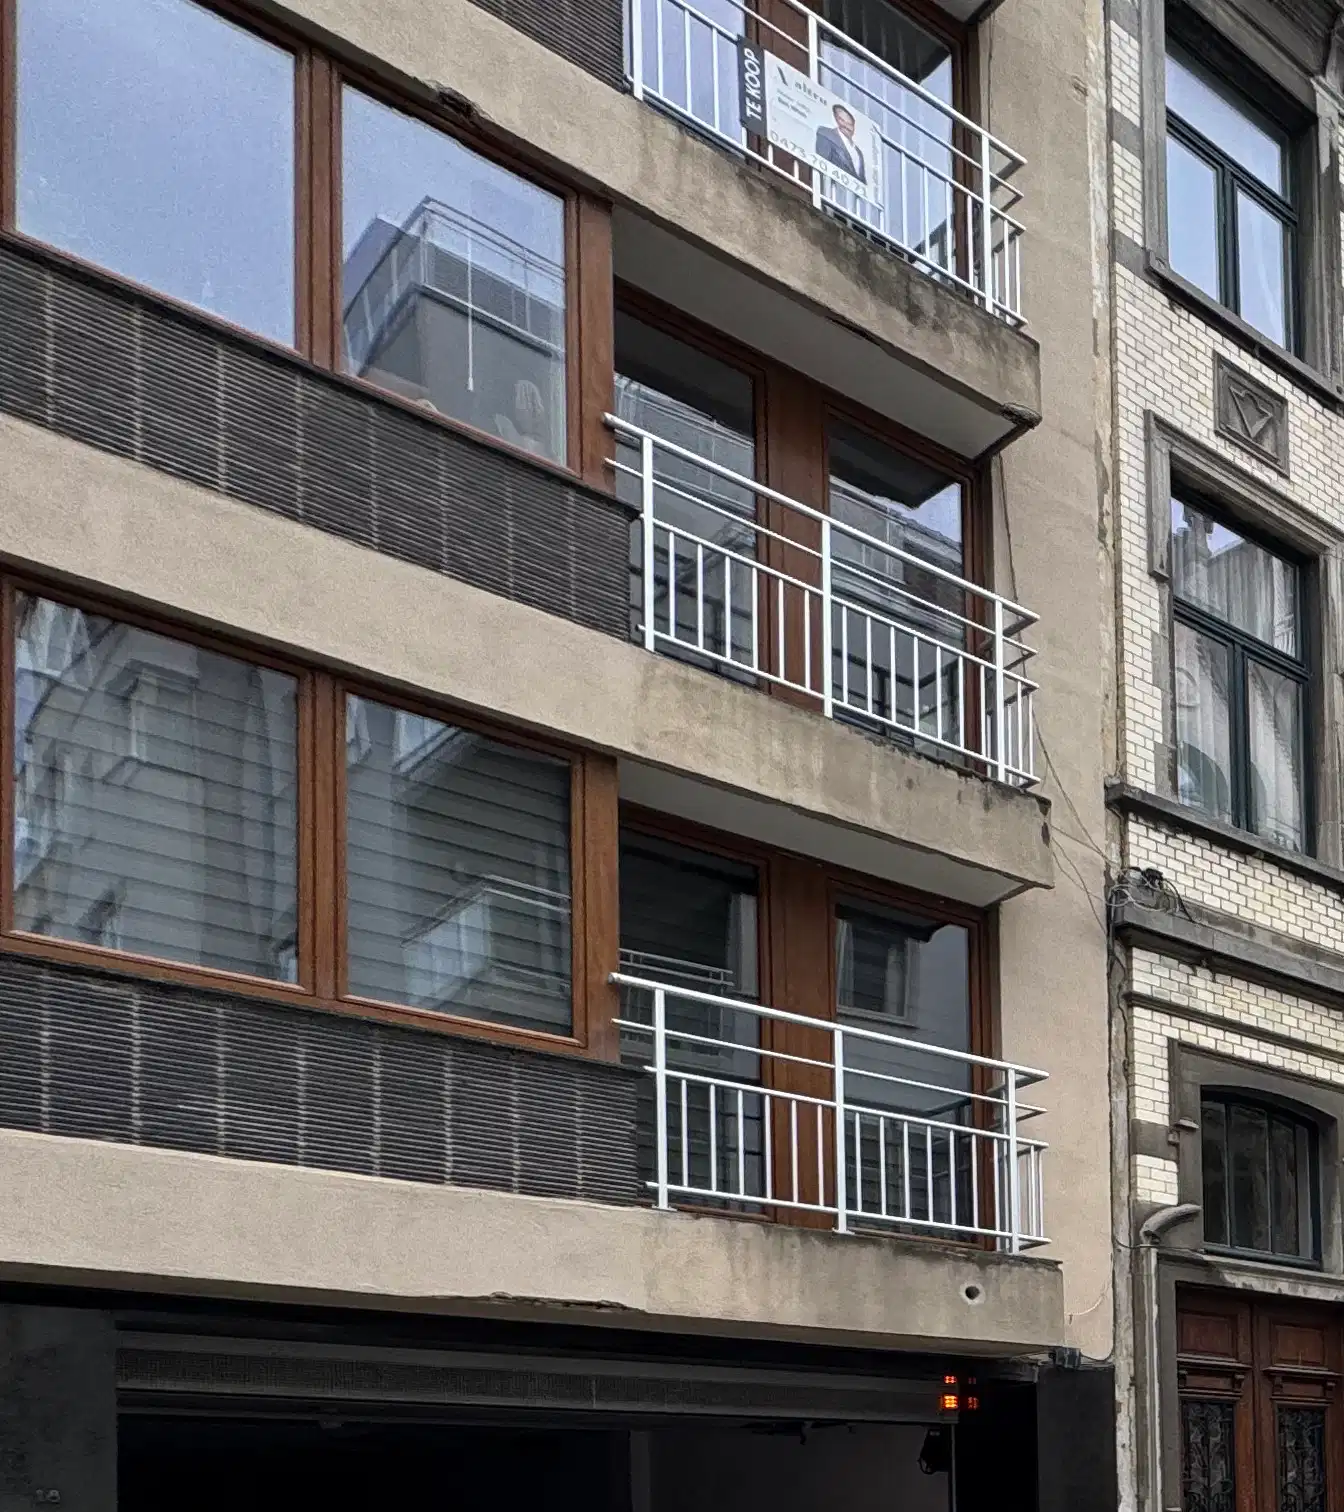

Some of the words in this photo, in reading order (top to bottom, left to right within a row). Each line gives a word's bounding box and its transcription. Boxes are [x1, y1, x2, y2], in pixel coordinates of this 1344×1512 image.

[744, 48, 761, 97] KOOP
[746, 99, 762, 121] TE
[770, 130, 807, 159] 0473
[808, 154, 828, 172] 70
[831, 171, 850, 187] 40
